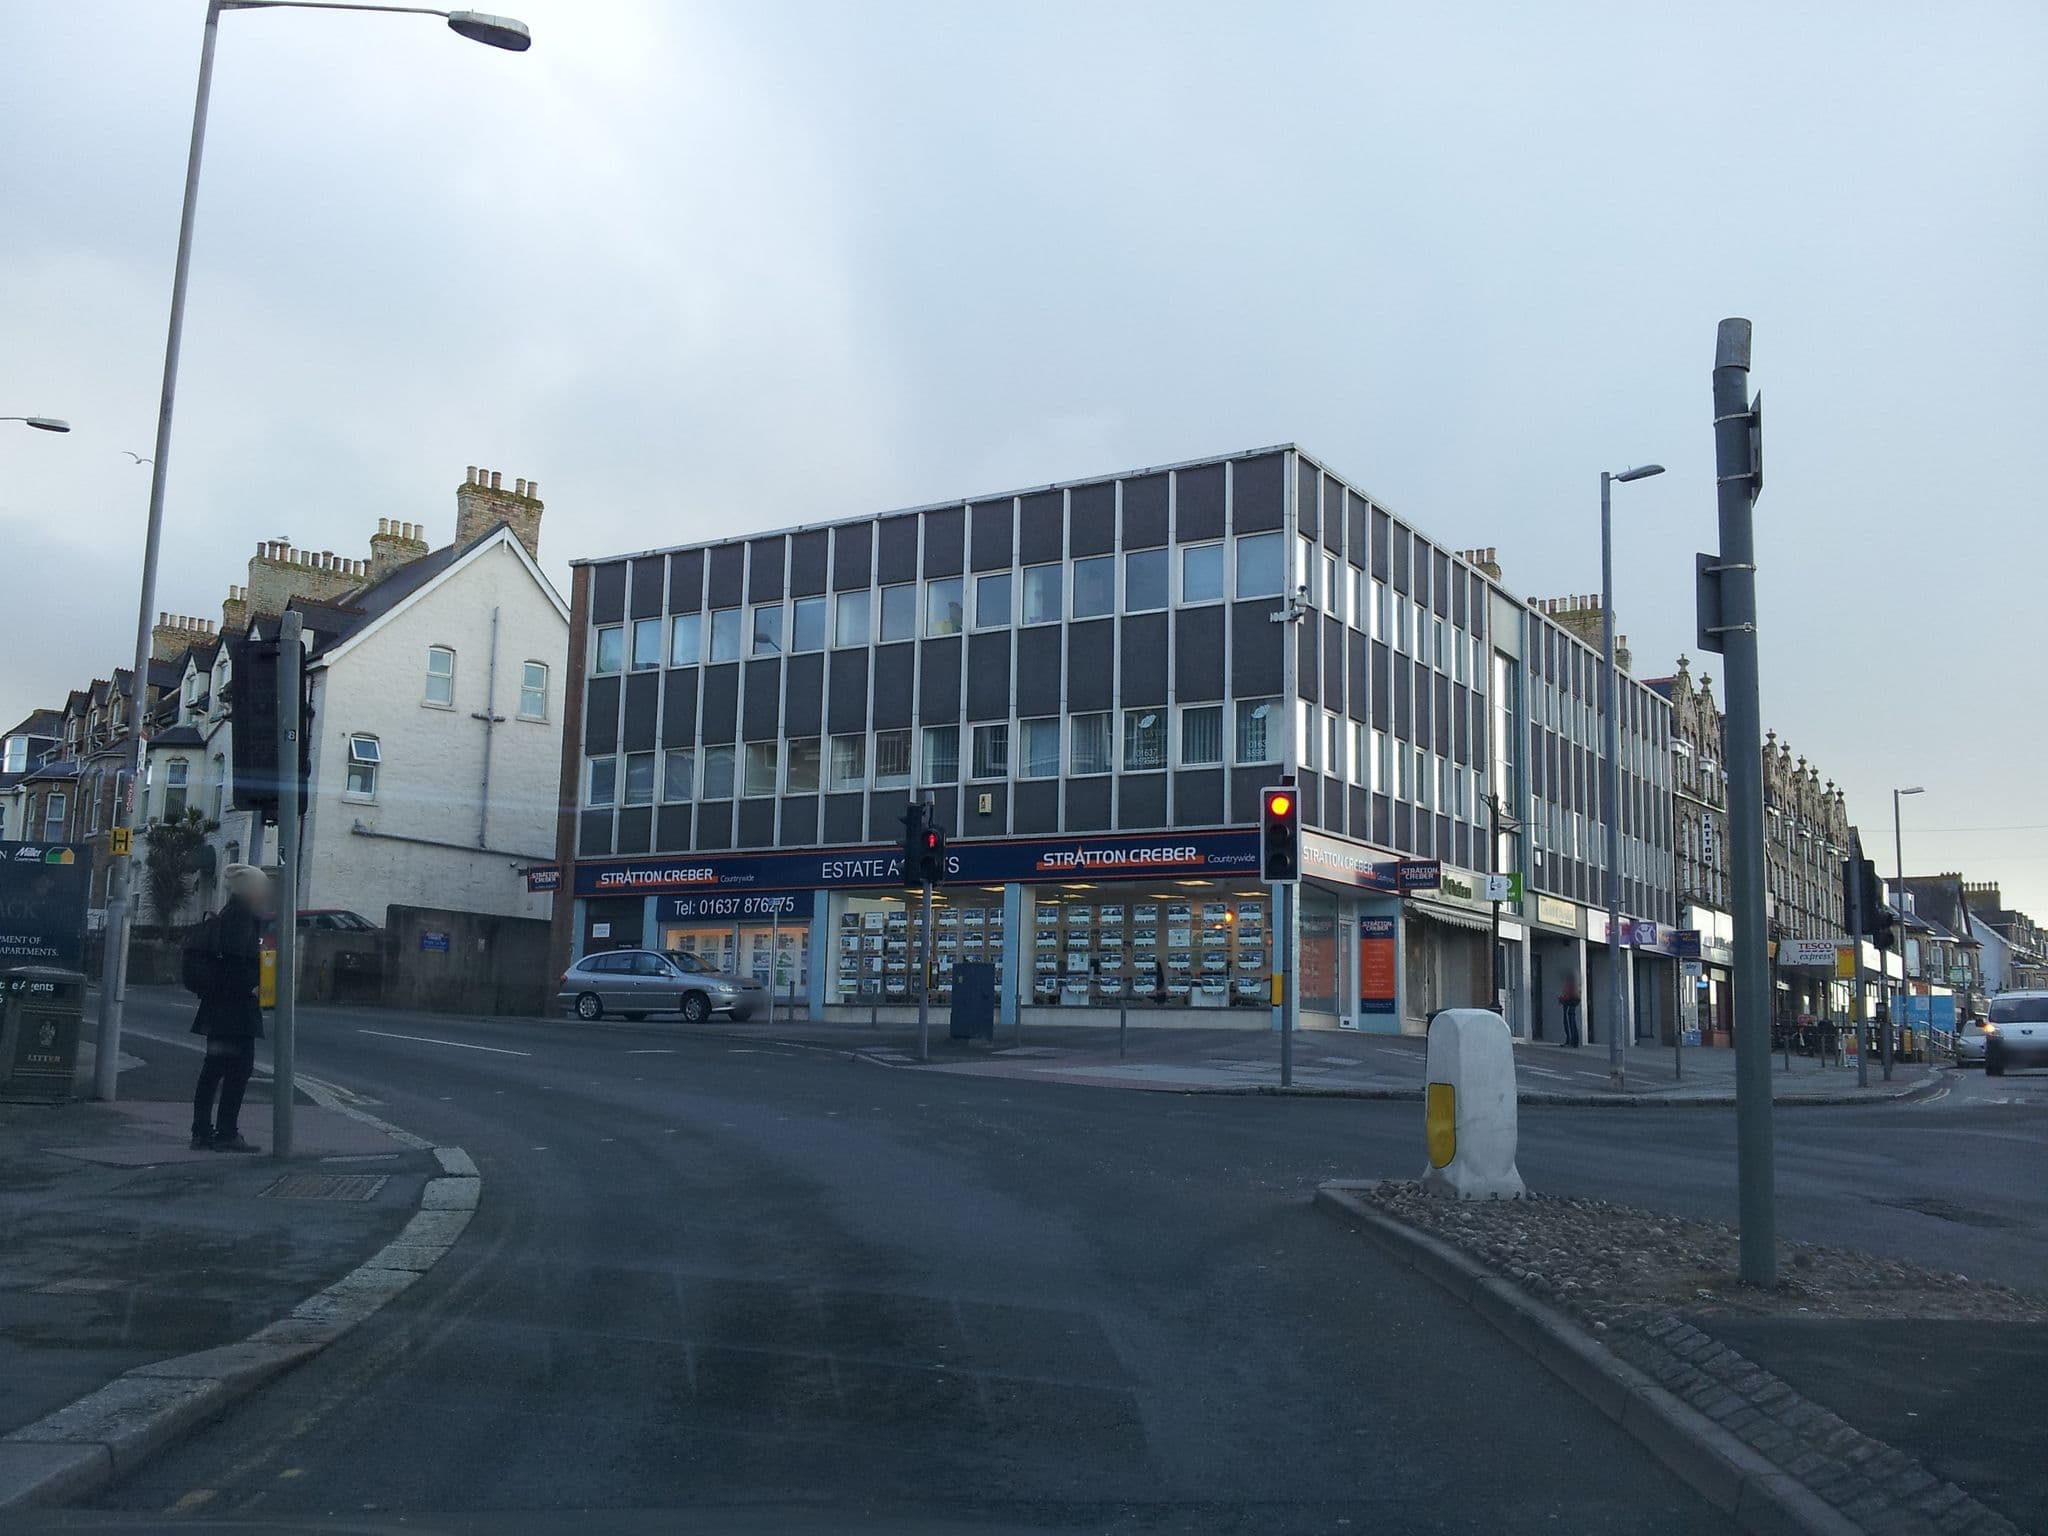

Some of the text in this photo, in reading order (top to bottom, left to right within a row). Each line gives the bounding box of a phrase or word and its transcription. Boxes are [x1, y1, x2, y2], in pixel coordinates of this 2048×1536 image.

[113, 831, 129, 851] H
[1703, 815, 1712, 862] TATTOO
[1043, 847, 1256, 867] STRATTON CREBER Countrywide
[1303, 846, 1344, 869] STRATTON
[601, 867, 662, 885] STRATTON
[664, 868, 713, 882] CREBER
[822, 860, 884, 878] ESTATE
[1401, 866, 1439, 875] STRATTON
[1405, 873, 1434, 881] CREBER
[674, 900, 696, 916] Tel:
[699, 898, 740, 915] 01637
[29, 936, 42, 945] OF
[1798, 942, 1832, 950] TESCO
[1799, 953, 1833, 962] express
